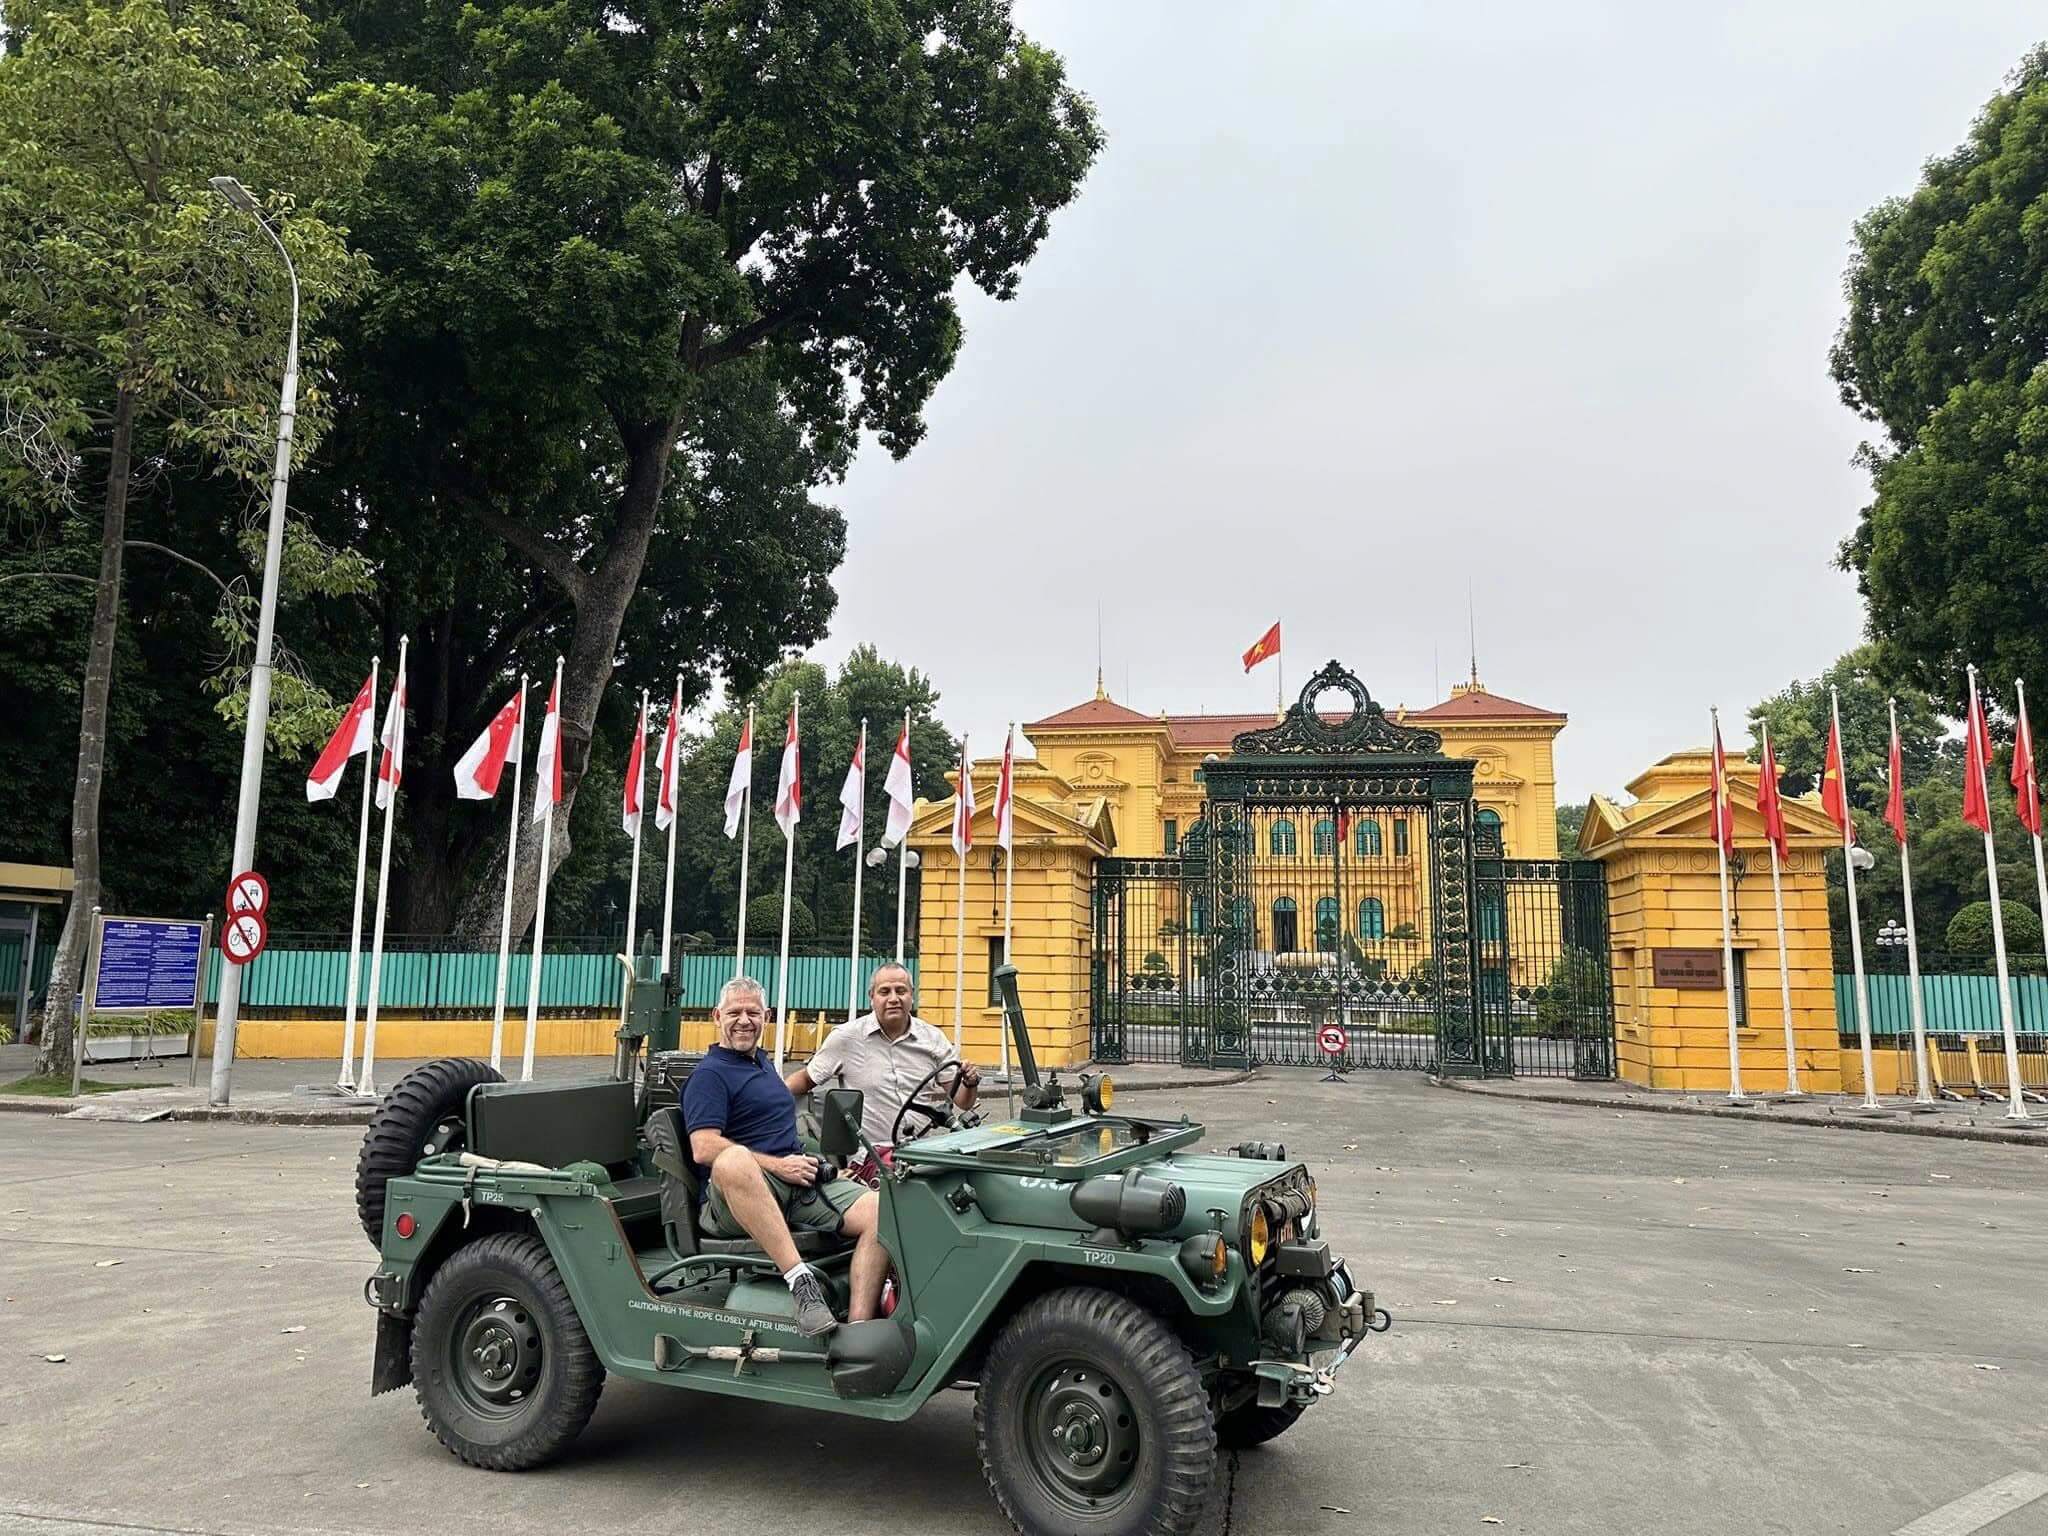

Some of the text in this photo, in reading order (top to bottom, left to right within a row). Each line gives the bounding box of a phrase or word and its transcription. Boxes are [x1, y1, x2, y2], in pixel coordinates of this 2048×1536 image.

[481, 1191, 504, 1202] TP25
[1083, 1250, 1116, 1264] TP20
[678, 1307, 692, 1317] THE
[693, 1310, 713, 1320] ROPE
[715, 1313, 747, 1325] CLOSELY
[748, 1319, 773, 1330] AFTER
[774, 1323, 798, 1334] USING
